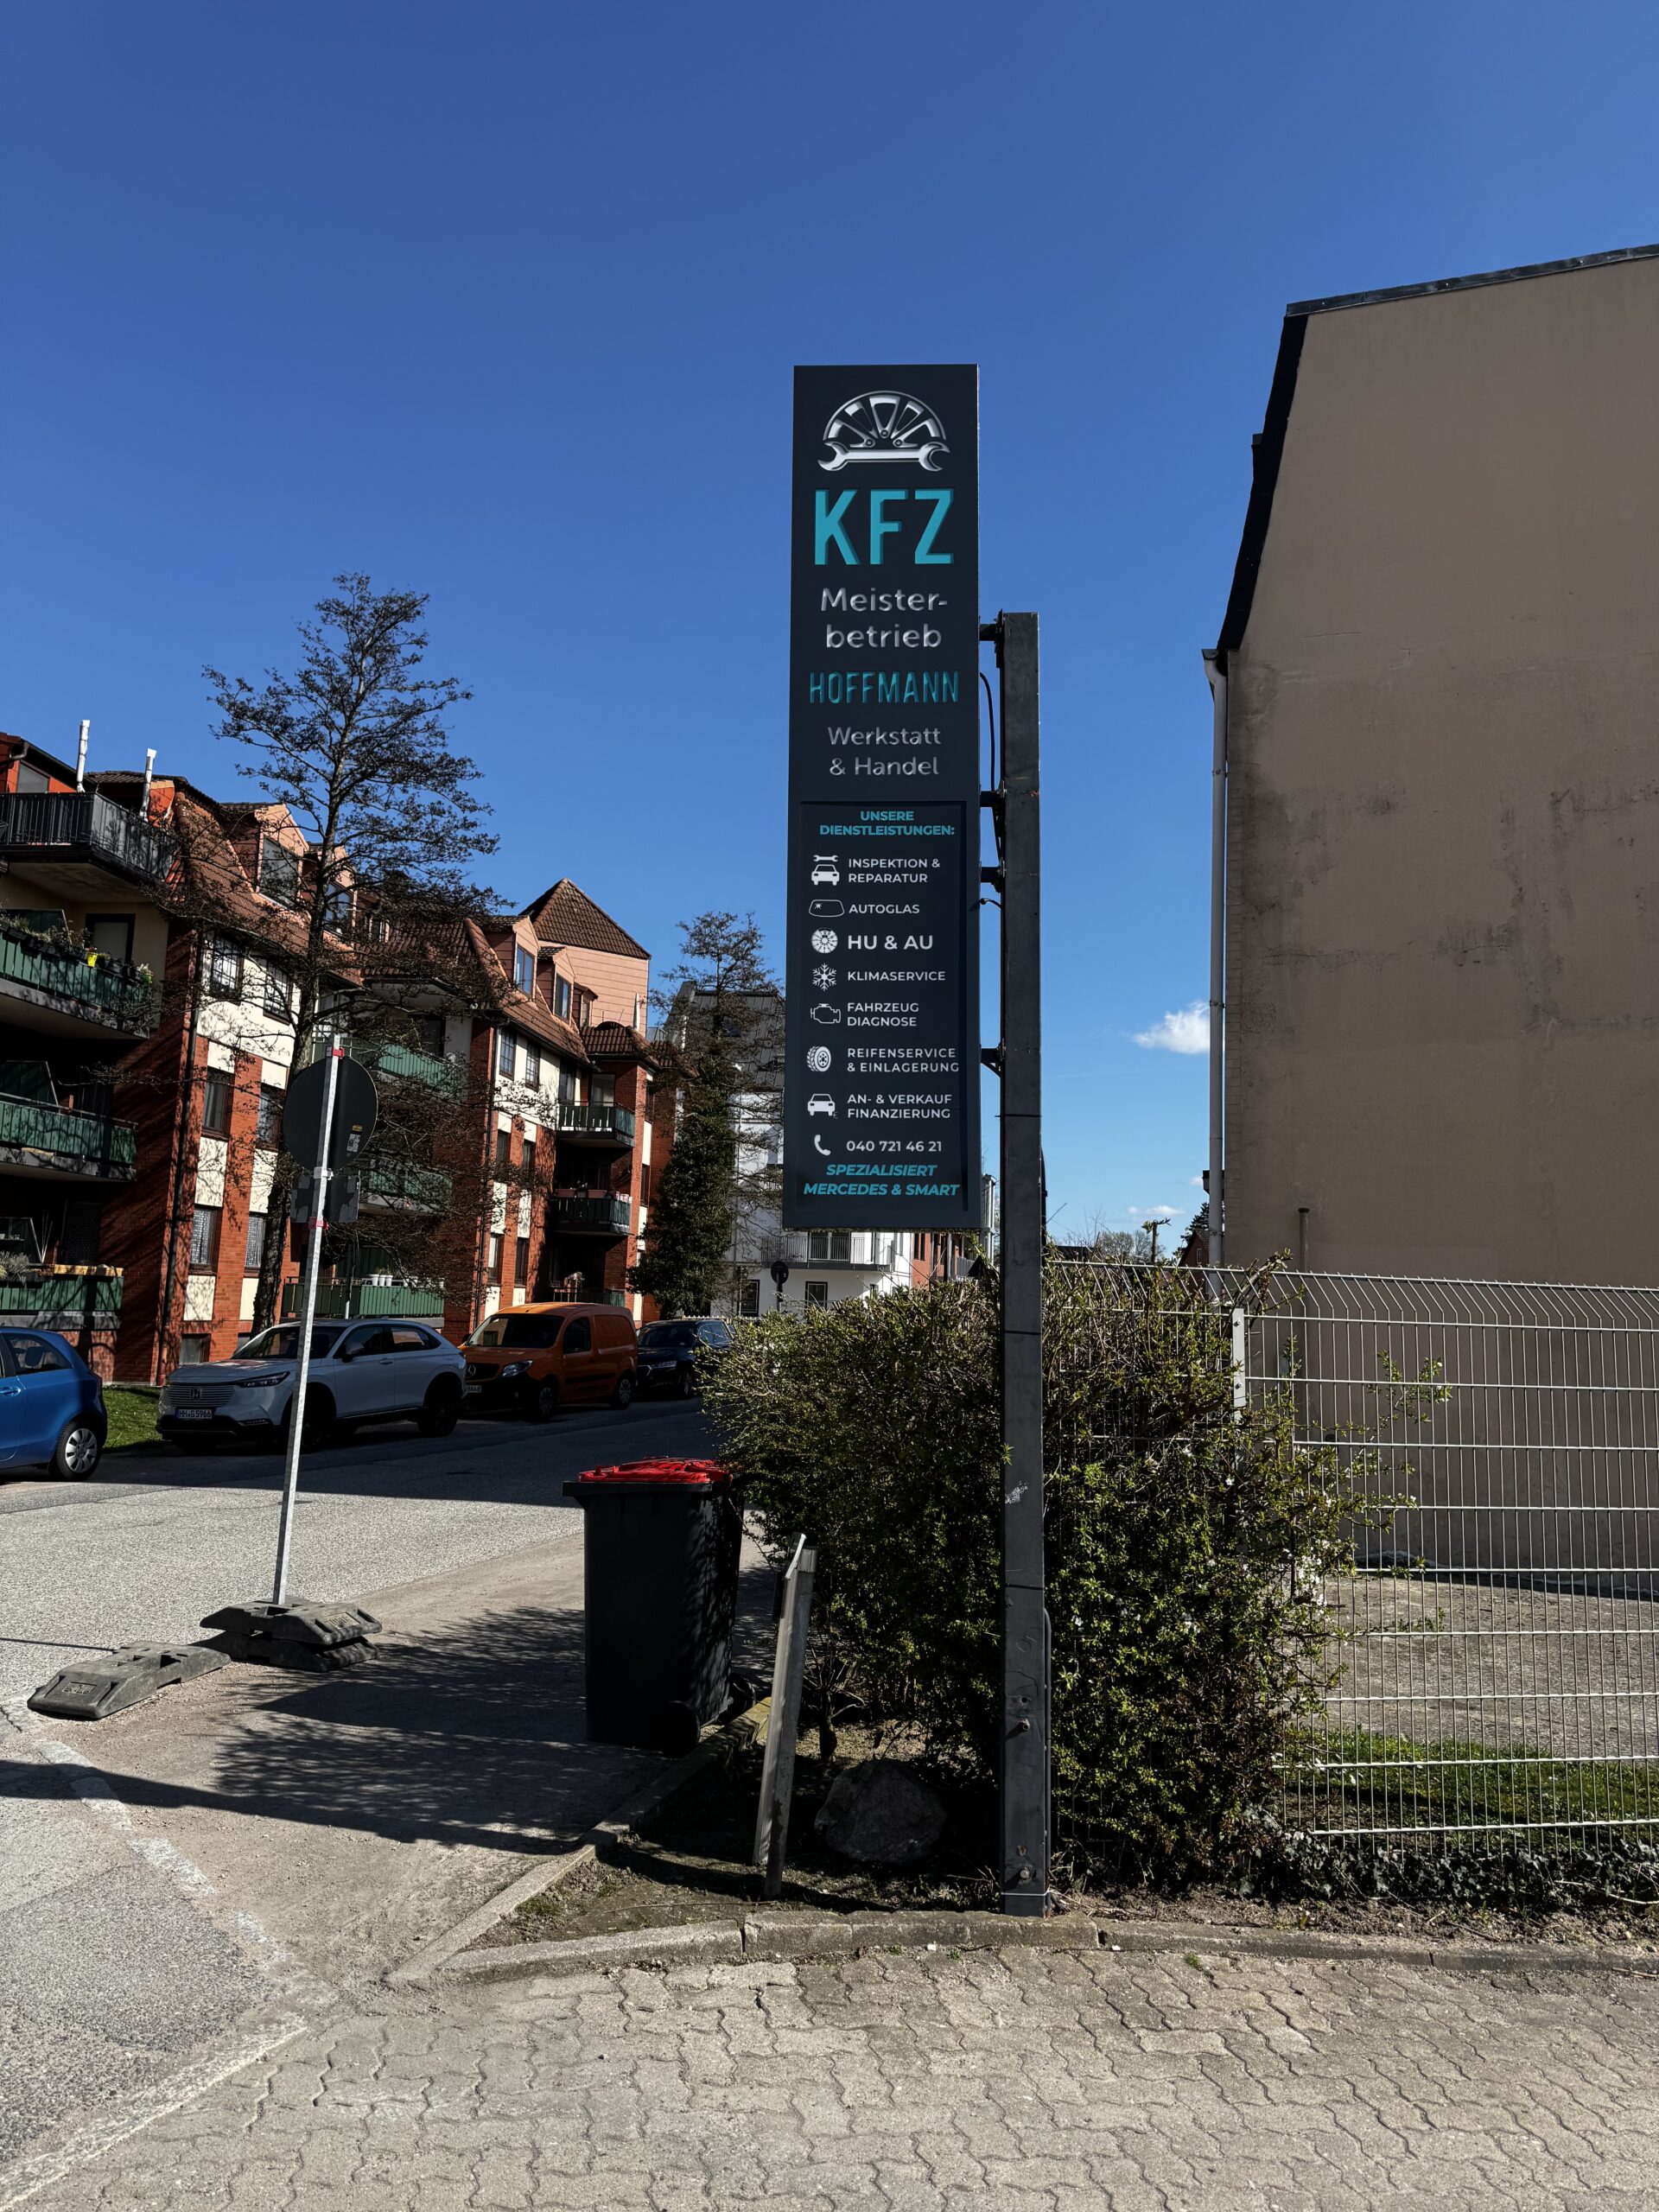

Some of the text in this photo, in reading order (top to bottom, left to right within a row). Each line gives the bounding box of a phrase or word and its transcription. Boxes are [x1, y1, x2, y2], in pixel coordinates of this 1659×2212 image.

[814, 488, 954, 565] KFZ
[821, 588, 948, 611] Meister-
[826, 625, 942, 648] betrieb
[810, 672, 958, 703] HOFFMANN
[828, 728, 941, 745] Werkstatt
[829, 757, 939, 775] & Handel
[860, 811, 914, 821] UNSERE
[819, 825, 955, 835] DIENSTLEISTUNGEN:
[849, 859, 940, 868] INSPEKTION &
[848, 874, 928, 882] REPARATUR
[849, 905, 920, 913] AUTOGLAS
[848, 936, 878, 950] HU
[884, 936, 897, 950] &
[903, 936, 933, 950] AU
[848, 971, 946, 981] KLIMASERVICE
[847, 1003, 919, 1012] FAHRZEUG
[847, 1017, 917, 1026] DIAGNOSE
[847, 1048, 956, 1058] REIFENSERVICE
[847, 1063, 959, 1072] & EINLAGERUNG
[847, 1095, 952, 1103] AN- & VERKAUF
[848, 1109, 950, 1118] FINANZIERUNG
[846, 1141, 942, 1152] 040 721 46 21
[826, 1165, 938, 1176] SPEZIALISIERT
[804, 1184, 960, 1195] MERCEDES & SMART
